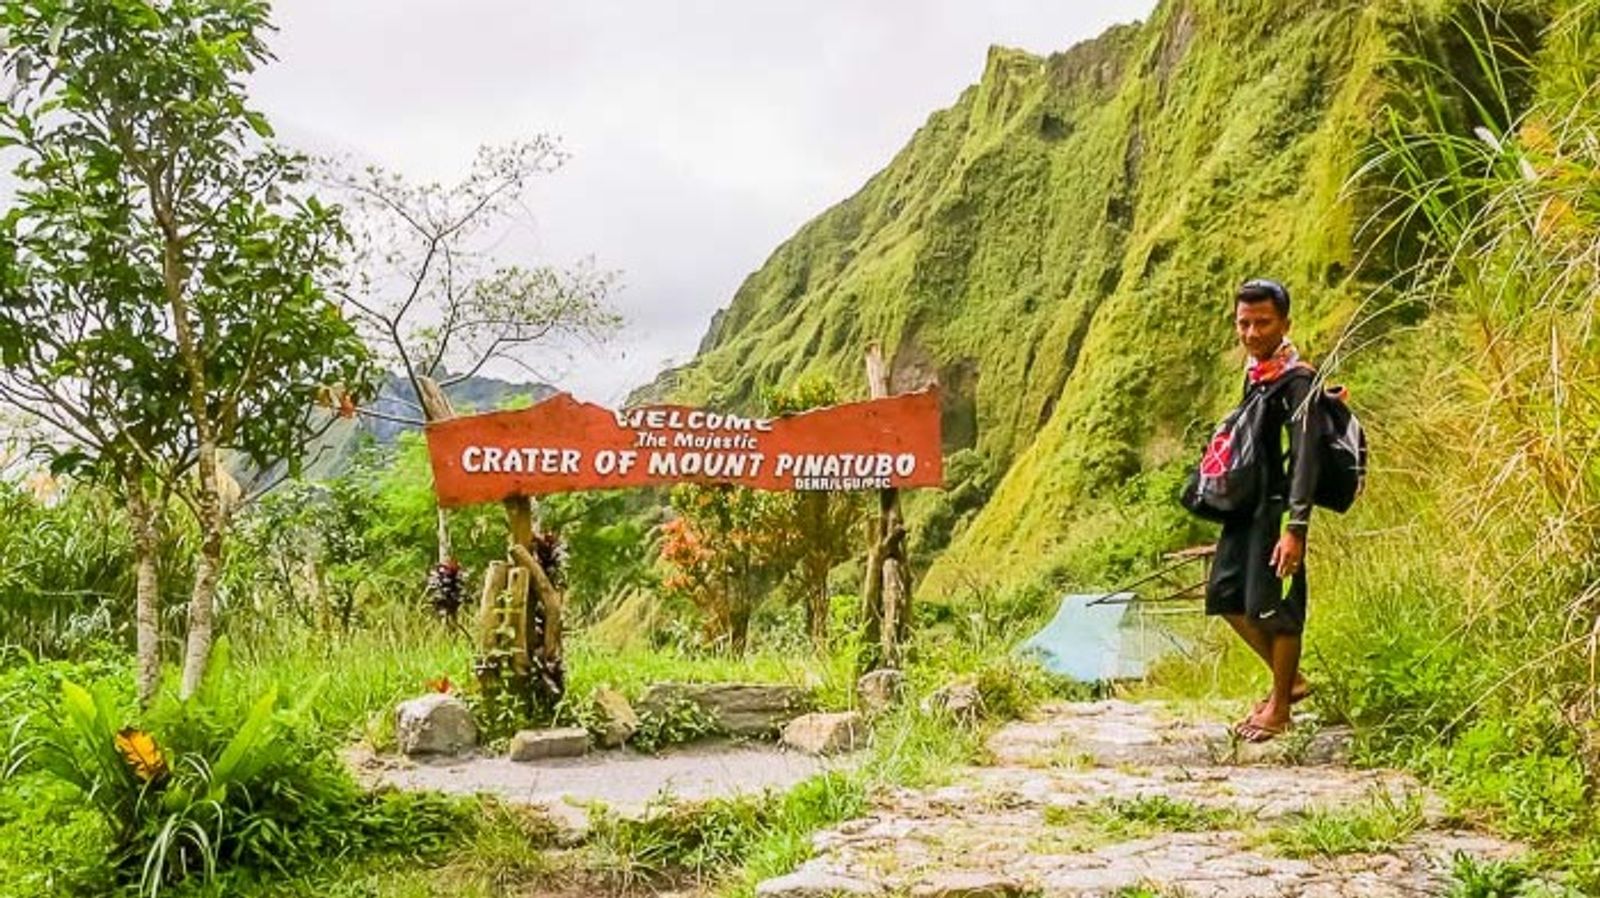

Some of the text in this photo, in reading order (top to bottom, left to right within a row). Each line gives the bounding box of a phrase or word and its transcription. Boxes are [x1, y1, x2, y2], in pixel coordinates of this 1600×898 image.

[614, 410, 772, 431] WELCOME
[636, 432, 758, 450] The Majestic
[461, 446, 916, 477] CRATER OF MOUNT PINATUBO
